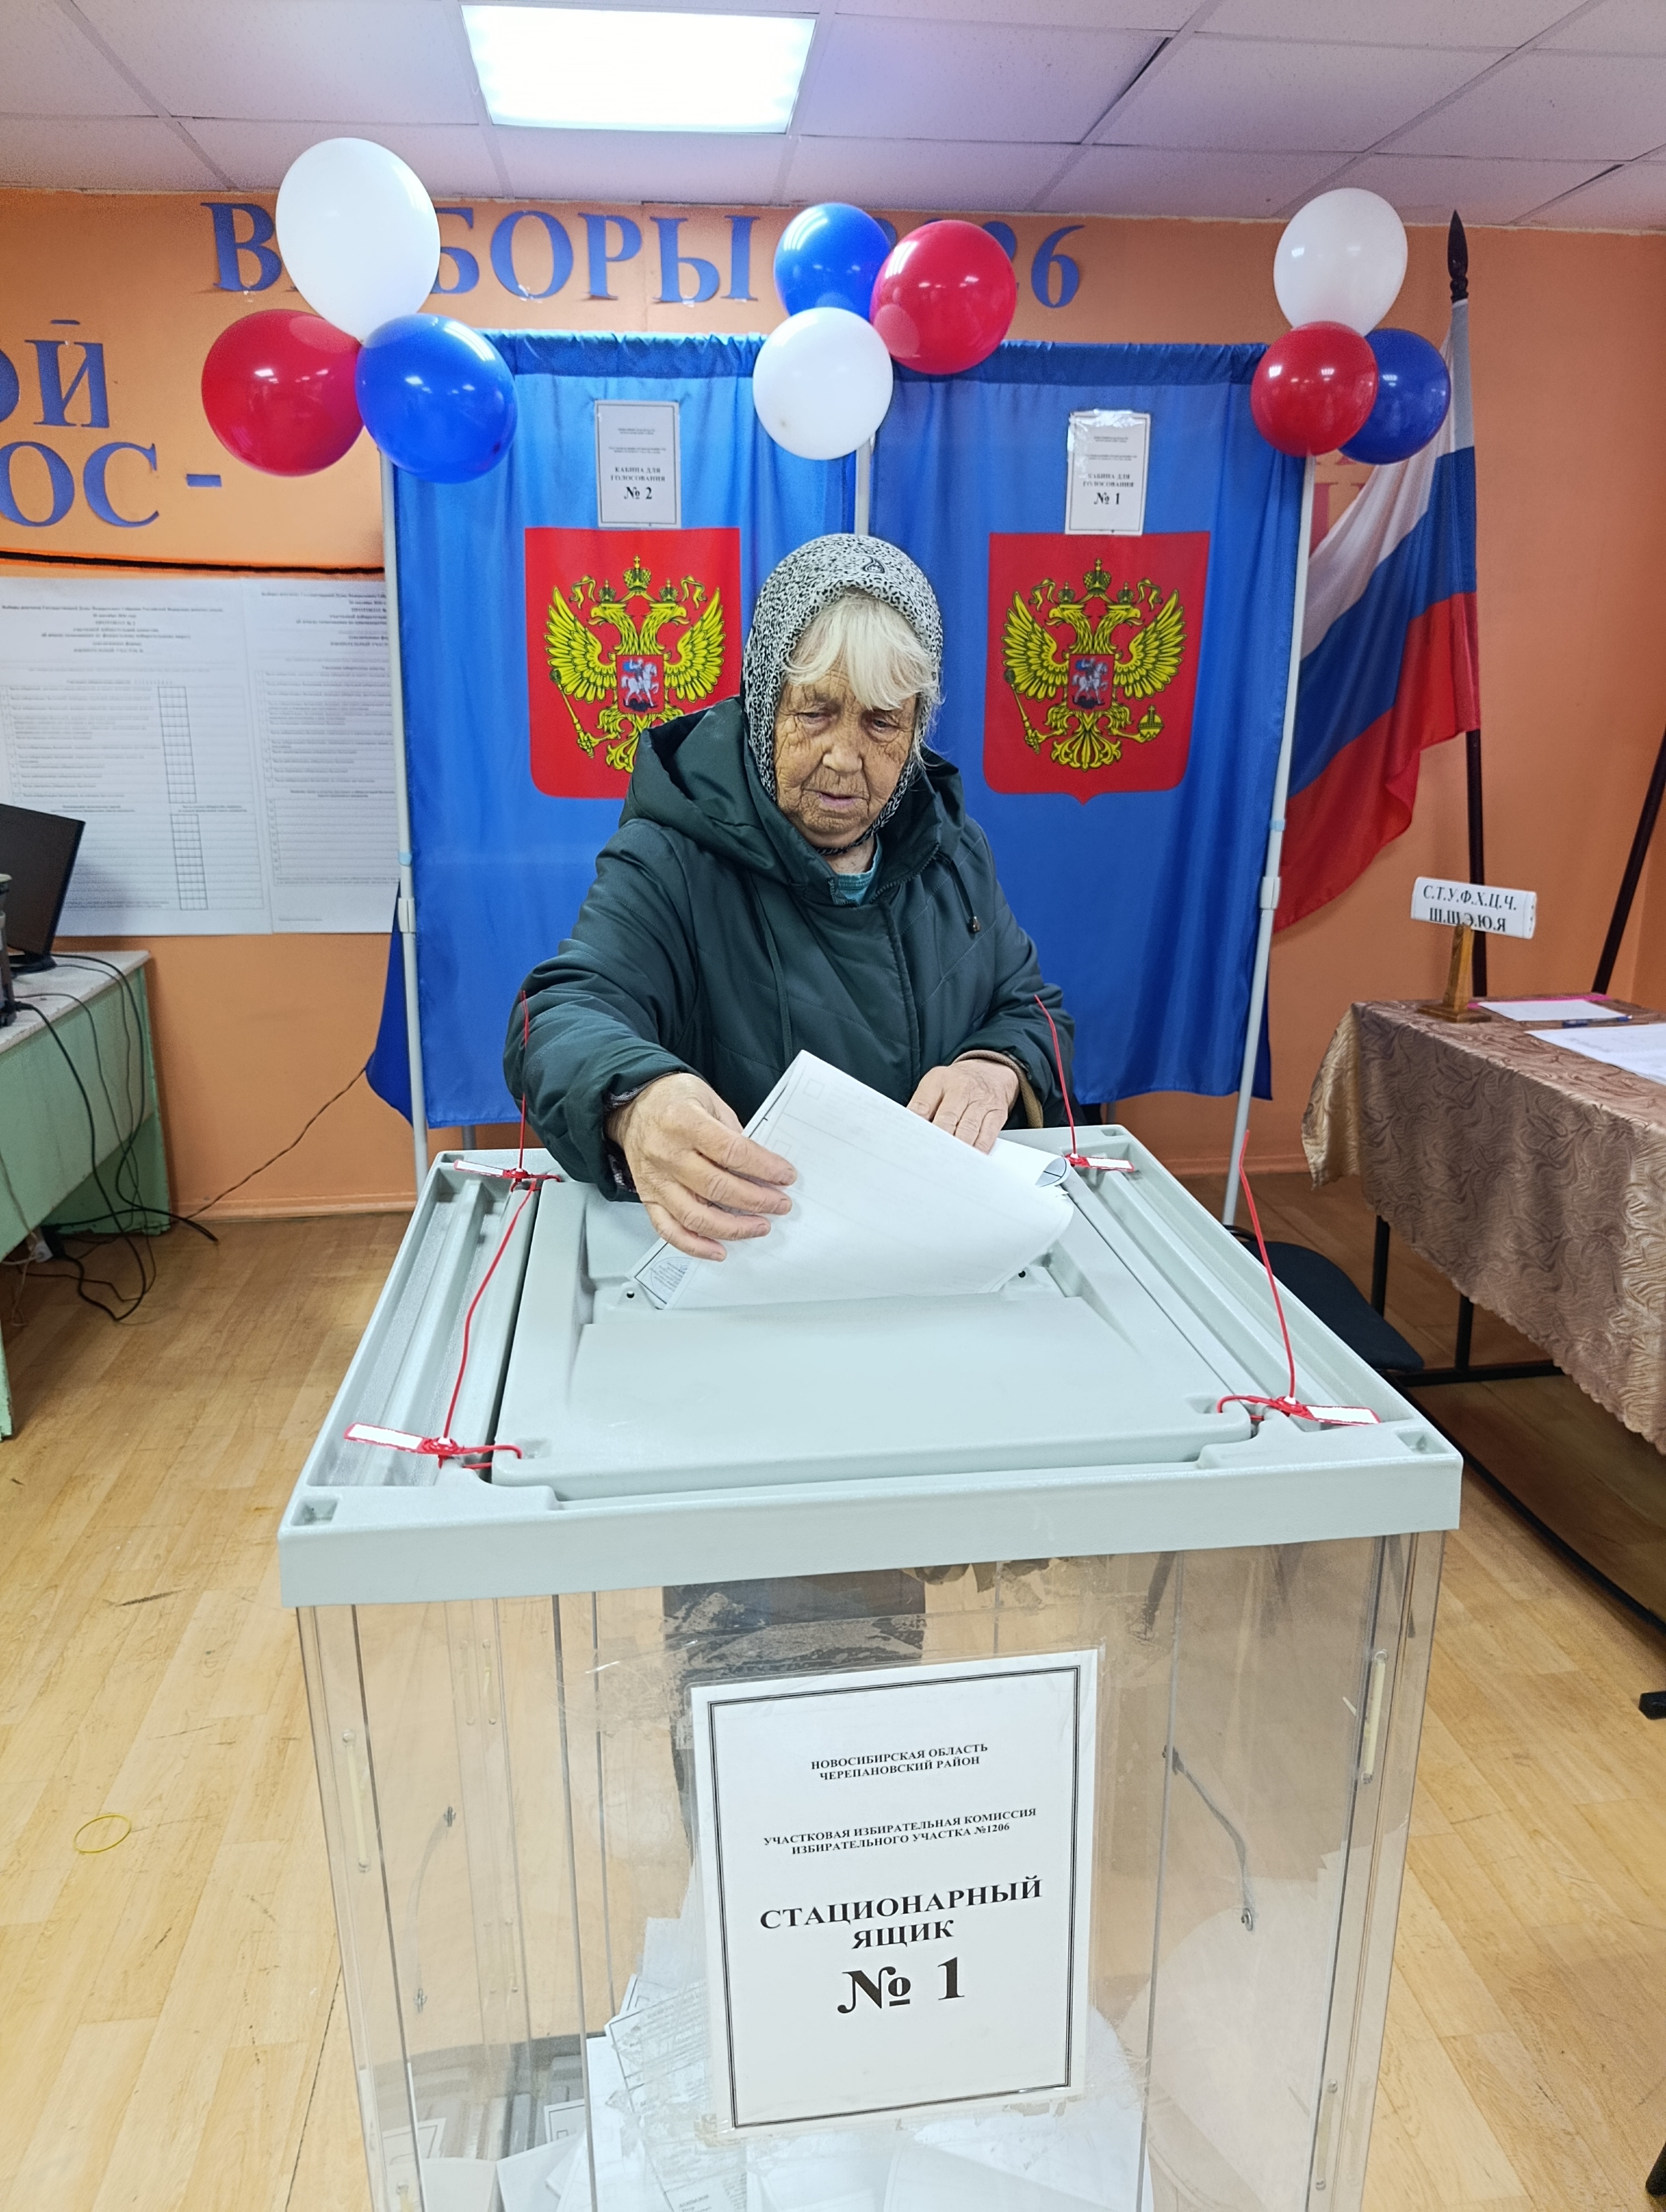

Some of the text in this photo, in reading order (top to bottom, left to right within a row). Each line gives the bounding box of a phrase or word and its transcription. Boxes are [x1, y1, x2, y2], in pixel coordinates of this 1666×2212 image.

[200, 202, 759, 303] ВБОРЫ
[624, 486, 653, 500] № 2
[1094, 492, 1120, 505] № 1
[811, 1744, 988, 1770] НОВОСИБИРСКАЯ ОБЛАСТЬ
[819, 1755, 980, 1780] ЧЕРЕПАНОВСКИЙ РАЙОН
[764, 1808, 1036, 1846] УЧАСТКОВАЯ ИЗБИРАТЕЛЬНАЯ КОМИССИЯ
[792, 1822, 1010, 1855] ИЗБИРАТЕЛЬНОГО УЧАСТКА №1206
[760, 1875, 1043, 1930] СТАЦИОНАРНЫЙ
[851, 1919, 954, 1950] ЯЩИК
[837, 1957, 965, 2015] № 1
